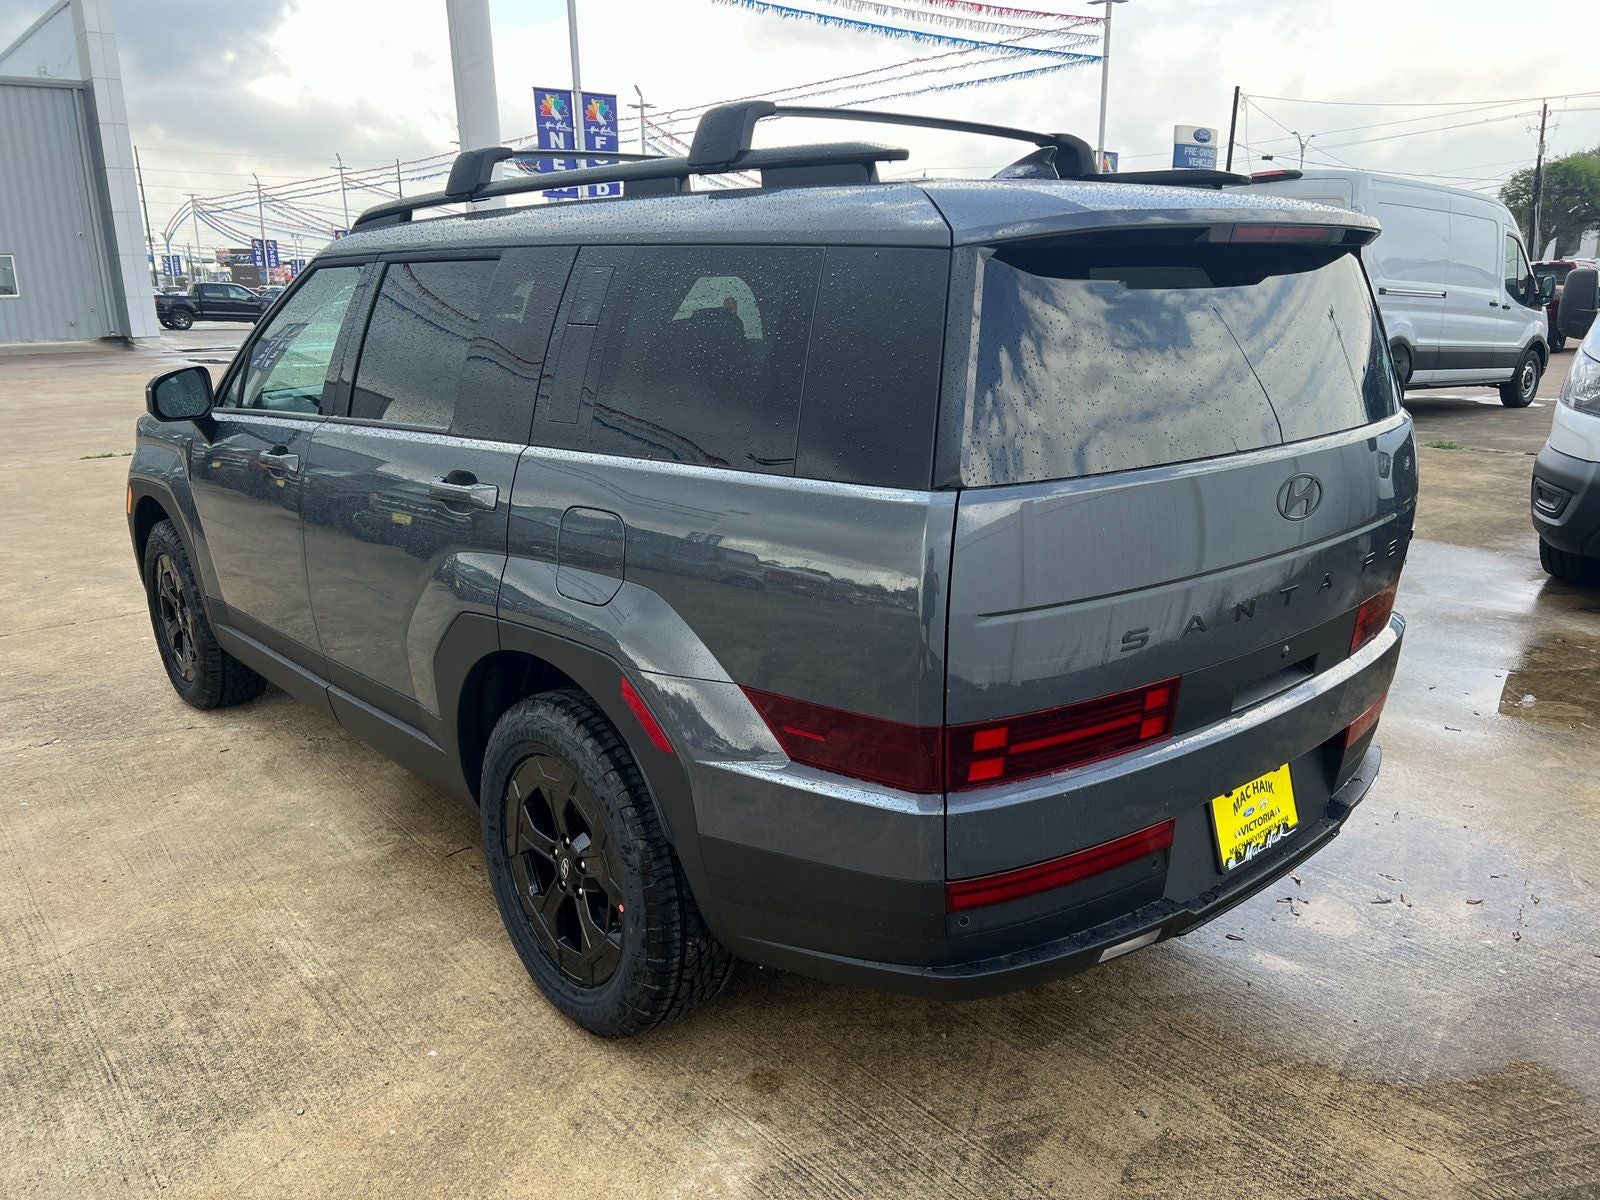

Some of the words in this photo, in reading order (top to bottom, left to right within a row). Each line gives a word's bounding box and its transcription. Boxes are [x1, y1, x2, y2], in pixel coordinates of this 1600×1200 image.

[549, 131, 567, 192] NE
[594, 136, 610, 196] FD
[1188, 157, 1214, 168] VEHICLES
[255, 250, 263, 267] NEW
[269, 250, 277, 267] FORD
[1120, 572, 1333, 653] SANTA
[1361, 539, 1397, 574] FE
[1232, 785, 1252, 816] MAC
[1252, 779, 1275, 795] HAIK
[1240, 809, 1276, 835] VICTORIA
